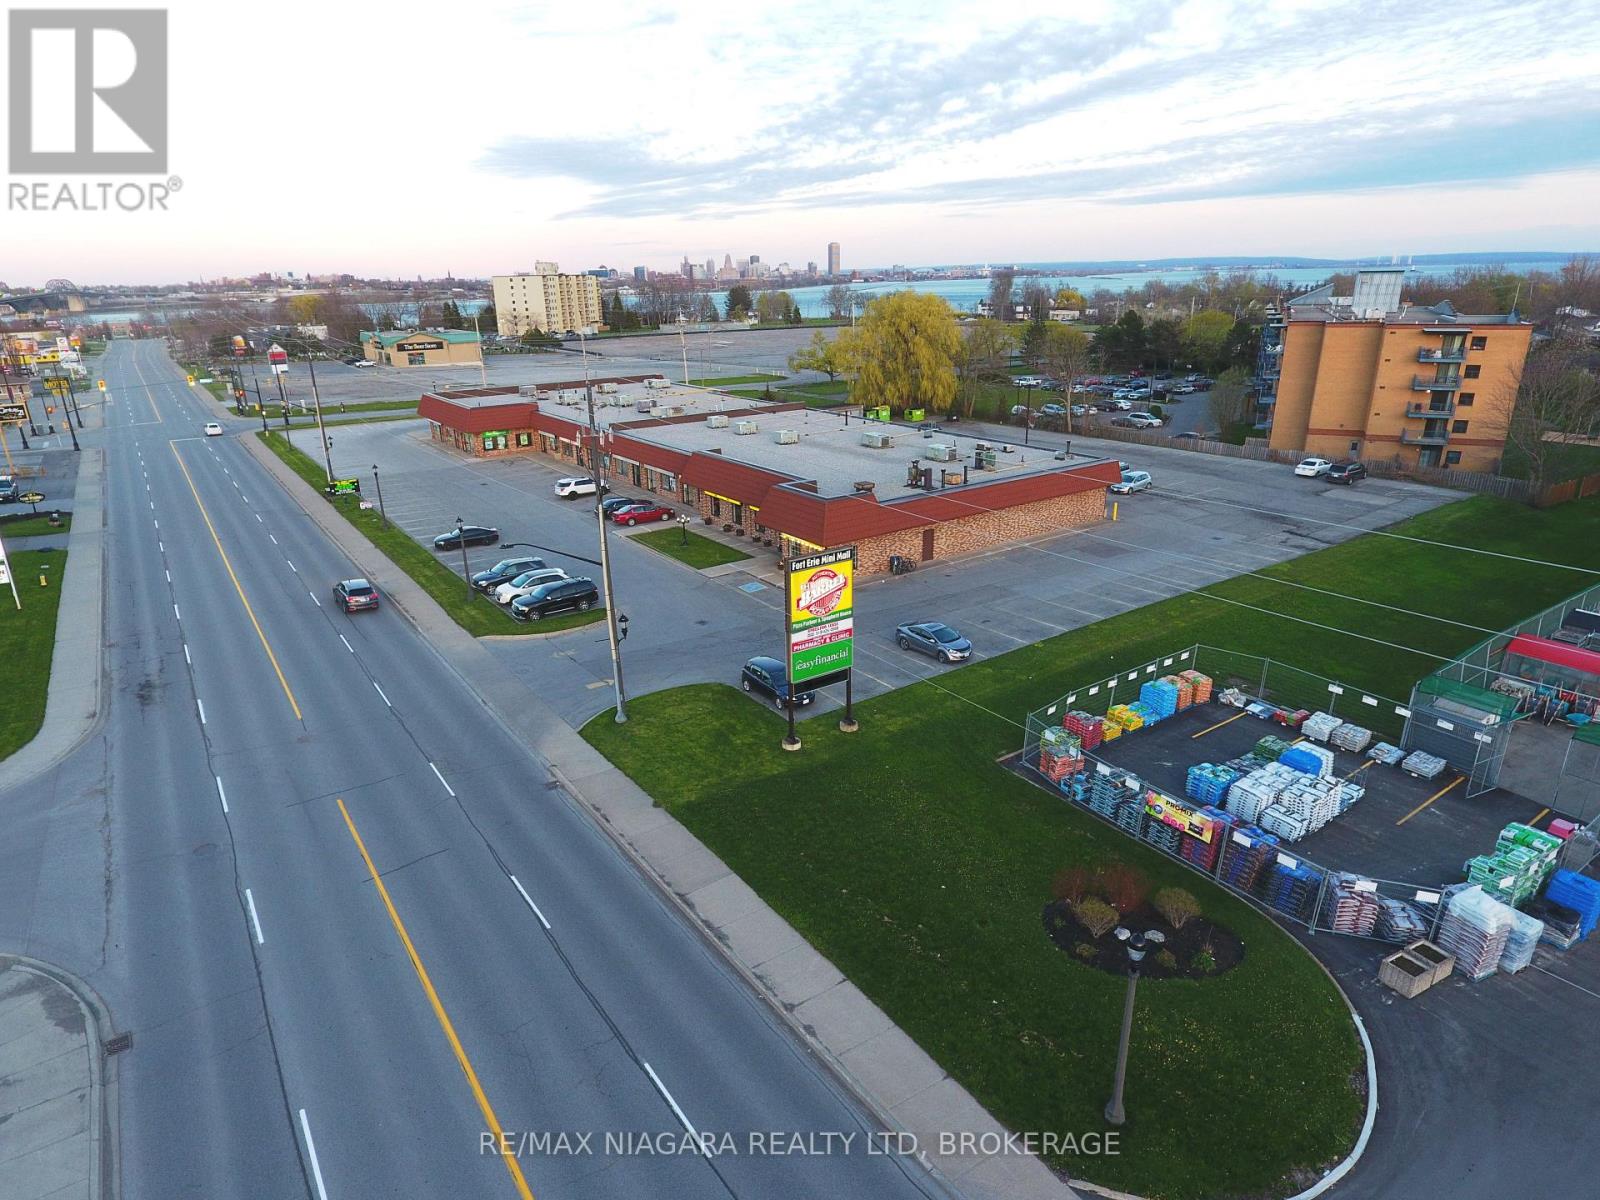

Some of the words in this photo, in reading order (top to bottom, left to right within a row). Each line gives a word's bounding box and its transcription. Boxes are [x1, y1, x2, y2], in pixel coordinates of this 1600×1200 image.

[791, 560, 806, 571] Fort
[806, 557, 821, 568] Erie
[820, 552, 836, 565] Mini
[836, 549, 851, 561] Mall
[793, 637, 825, 652] PHARMACY
[831, 631, 850, 642] CLINIC
